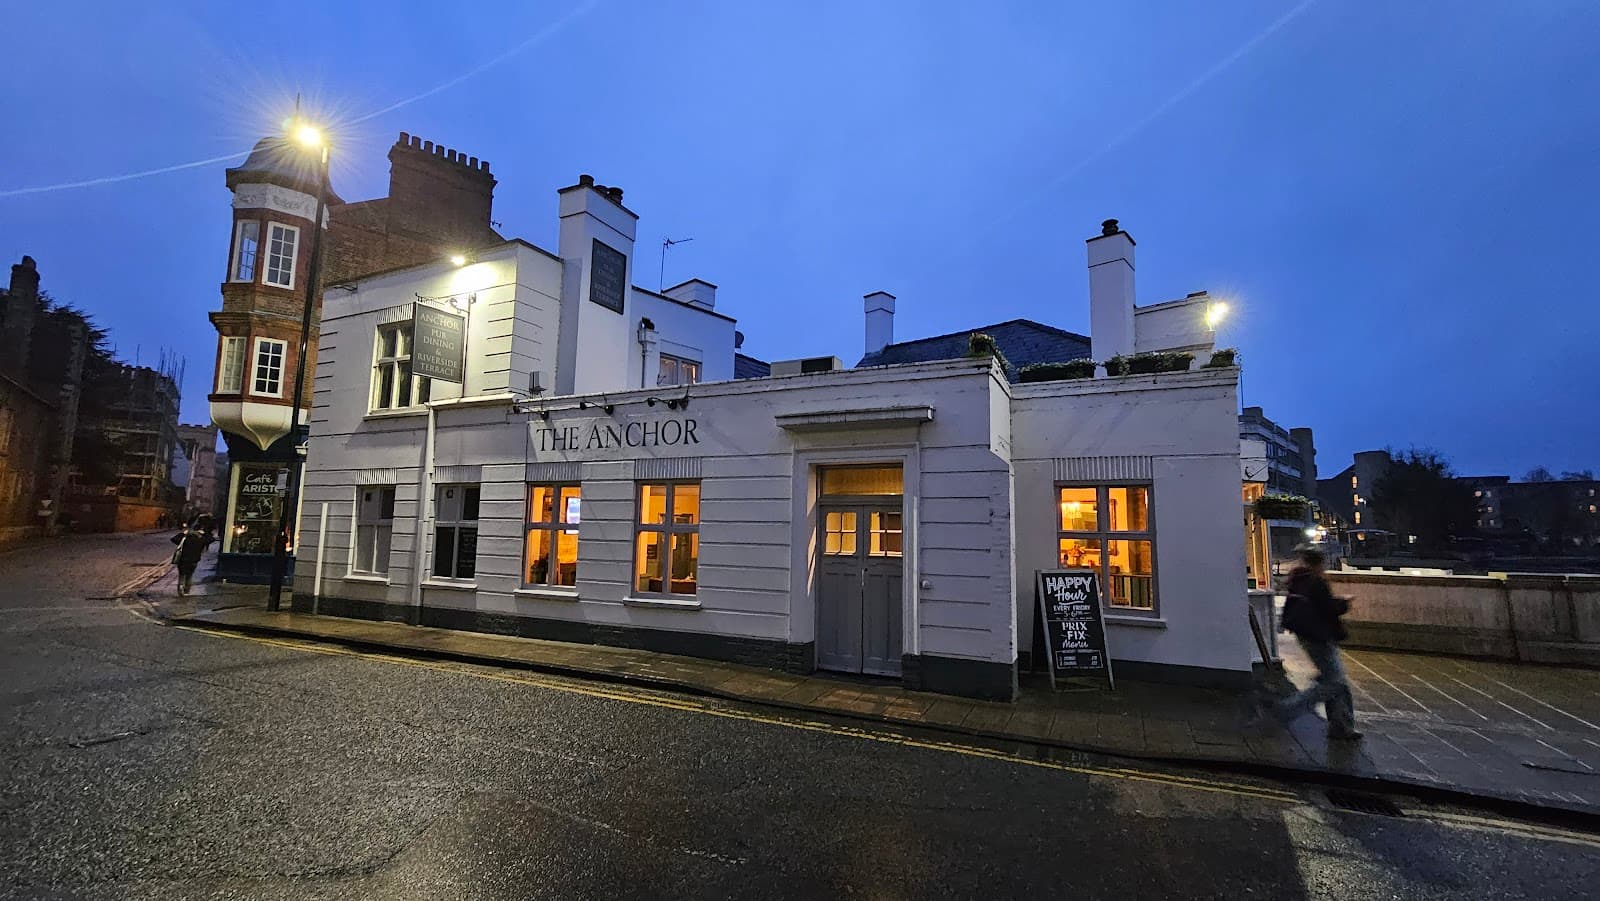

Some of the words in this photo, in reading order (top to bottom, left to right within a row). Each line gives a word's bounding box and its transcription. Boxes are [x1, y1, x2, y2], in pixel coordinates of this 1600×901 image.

[420, 313, 459, 329] ANCHOR
[423, 335, 455, 350] DINING
[417, 353, 457, 369] RIVERSIDE
[421, 362, 455, 376] TERRACE
[537, 427, 579, 451] THE
[586, 419, 700, 449] ANCHOR
[246, 474, 273, 483] Café
[1046, 577, 1092, 594] HAPPY
[1055, 587, 1087, 601] Hour
[1062, 622, 1088, 631] PRIX
[1068, 631, 1086, 640] FIX
[1062, 639, 1089, 648] Menu
